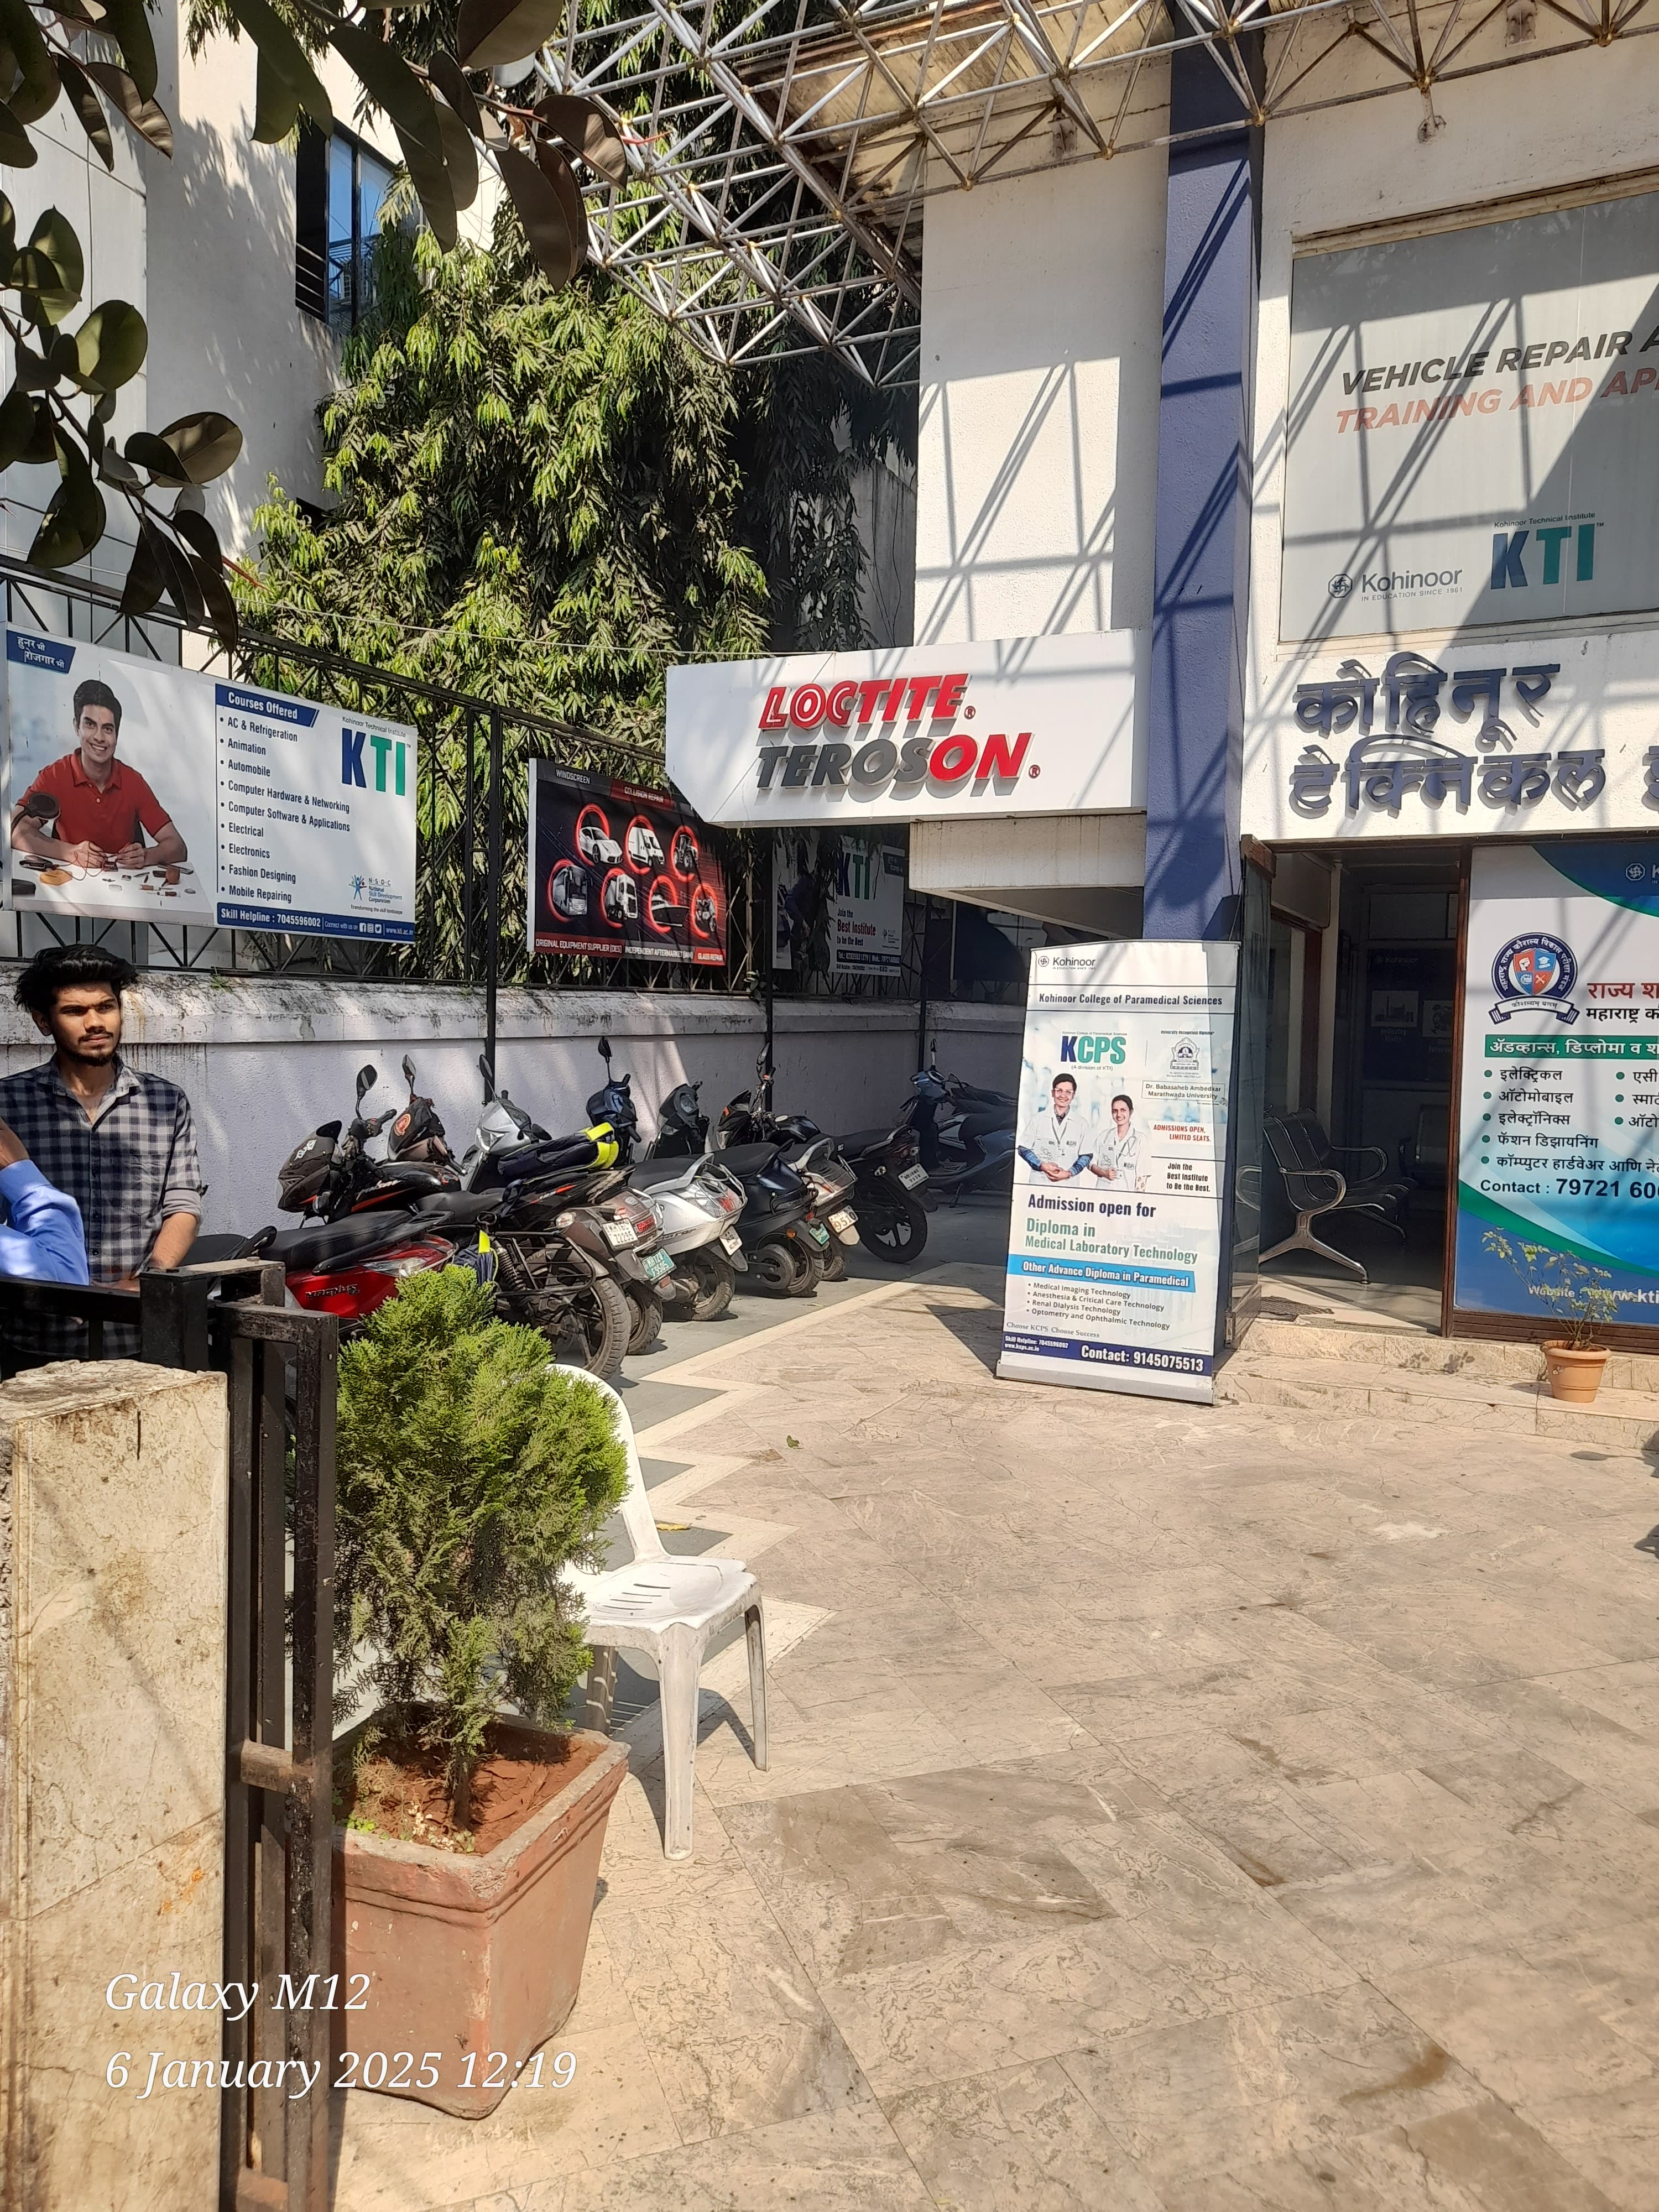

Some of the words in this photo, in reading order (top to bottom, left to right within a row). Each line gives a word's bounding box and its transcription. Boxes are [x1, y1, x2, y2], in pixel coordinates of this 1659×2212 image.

[1342, 351, 1489, 395] VEHICLE
[1495, 331, 1632, 374] REPAIR
[1335, 389, 1503, 434] TRAINING
[1509, 377, 1593, 414] AND
[1600, 367, 1659, 399] AP
[1493, 519, 1526, 529] Kohinoor
[1528, 515, 1563, 525] Technical
[1564, 512, 1595, 521] Institute
[1362, 569, 1463, 593] Kohinoor
[1371, 591, 1417, 601] EDUCATION
[1419, 588, 1443, 597] SINCE
[17, 636, 35, 649] हुनर
[36, 642, 45, 651] भी
[56, 659, 65, 669] भी
[1296, 651, 1561, 741] कोहिनूर
[227, 691, 264, 712] Courses
[265, 701, 298, 722] Offered
[227, 716, 238, 730] AC
[241, 719, 247, 732] &
[249, 722, 298, 744] Refrigeration
[342, 716, 364, 728] Kohinoor
[227, 738, 267, 757] Animation
[228, 759, 271, 777] Automobile
[556, 768, 591, 785] WINDSCREEN
[1293, 734, 1606, 810] टेक्निकल
[228, 780, 265, 797] Computer
[267, 787, 302, 805] Hardware
[304, 795, 310, 807] &
[311, 796, 350, 816] Networking
[624, 786, 648, 800] COLLISION
[648, 792, 664, 804] REPAIR
[228, 801, 265, 818] Computer
[267, 808, 300, 825] Software
[301, 815, 307, 825] &
[309, 815, 351, 832] Applications
[228, 822, 264, 838] Electrical
[228, 843, 271, 859] Electronics
[228, 864, 258, 879] Fashion
[260, 868, 296, 885] Designing
[837, 852, 870, 900] KTI
[228, 884, 255, 899] Mobile
[257, 889, 293, 904] Repairing
[221, 908, 238, 921] Skill
[240, 911, 270, 925] Helpline
[276, 914, 321, 928] 7045596002
[837, 908, 846, 917] Join
[837, 919, 851, 933] Best
[852, 921, 876, 936] Institute
[536, 938, 560, 948] ORIGINAL
[560, 940, 587, 950] EQUIPMENT
[587, 943, 609, 952] SUPPLIER
[625, 946, 654, 956] INDEPENDENT
[654, 949, 682, 958] AFTERMARKET
[1052, 957, 1096, 967] Kohinoor
[1039, 993, 1077, 1004] Kohinoor
[1079, 994, 1111, 1006] College
[1114, 994, 1122, 1004] of
[1125, 994, 1180, 1005] Paramedical
[1183, 995, 1223, 1006] Sciences
[1587, 982, 1635, 999] राज्य
[1585, 1008, 1640, 1024] महाराष्ट्र
[1061, 1035, 1127, 1065] KCPS
[1564, 1039, 1626, 1055] डिप्लोमा
[1630, 1043, 1642, 1055] व
[1499, 1066, 1563, 1083] इलेक्ट्रिकल
[1632, 1069, 1659, 1083] एसी
[1498, 1088, 1574, 1105] ऑटोमोबाइल
[1498, 1110, 1571, 1127] इलेक्ट्रॉनिक्स
[1498, 1131, 1531, 1145] फॅशन
[1535, 1133, 1599, 1149] डिझायनिंग
[1496, 1153, 1549, 1170] कॉम्प्युटर
[1552, 1155, 1605, 1171] हार्डवेअर
[1609, 1158, 1642, 1173] आणि
[1182, 1173, 1208, 1182] Institute
[1480, 1179, 1541, 1194] Contact
[1556, 1178, 1619, 1197] 79721
[1027, 1194, 1095, 1213] Admission
[1099, 1202, 1131, 1217] open
[1136, 1202, 1156, 1218] for
[1026, 1218, 1079, 1236] Diploma
[1083, 1223, 1096, 1237] in
[1025, 1235, 1066, 1250] Medical
[1070, 1239, 1130, 1258] Laboratory
[1133, 1244, 1197, 1264] Technology
[1022, 1261, 1047, 1273] Other
[1048, 1263, 1083, 1277] Advance
[1085, 1266, 1120, 1280] Diploma
[1122, 1270, 1131, 1281] in
[1133, 1272, 1190, 1287] Paramedical
[1033, 1282, 1060, 1291] Medical
[1061, 1285, 1089, 1295] Imaging
[1091, 1288, 1131, 1300] Technology
[1032, 1291, 1070, 1301] Anesthesia
[1079, 1296, 1104, 1305] Critical
[1123, 1300, 1165, 1312] Technology
[1053, 1302, 1079, 1311] Dialysis
[1081, 1305, 1121, 1317] Technology
[1031, 1308, 1069, 1319] Optometry
[1086, 1314, 1127, 1325] Ophthalmic
[1128, 1320, 1170, 1332] Technology
[1051, 1327, 1074, 1335] Choose
[1075, 1330, 1100, 1338] Success
[1005, 1335, 1016, 1344] Skill
[1039, 1339, 1069, 1349] 7045596002
[1081, 1344, 1130, 1363] Contact:
[1133, 1351, 1203, 1372] 9145075513
